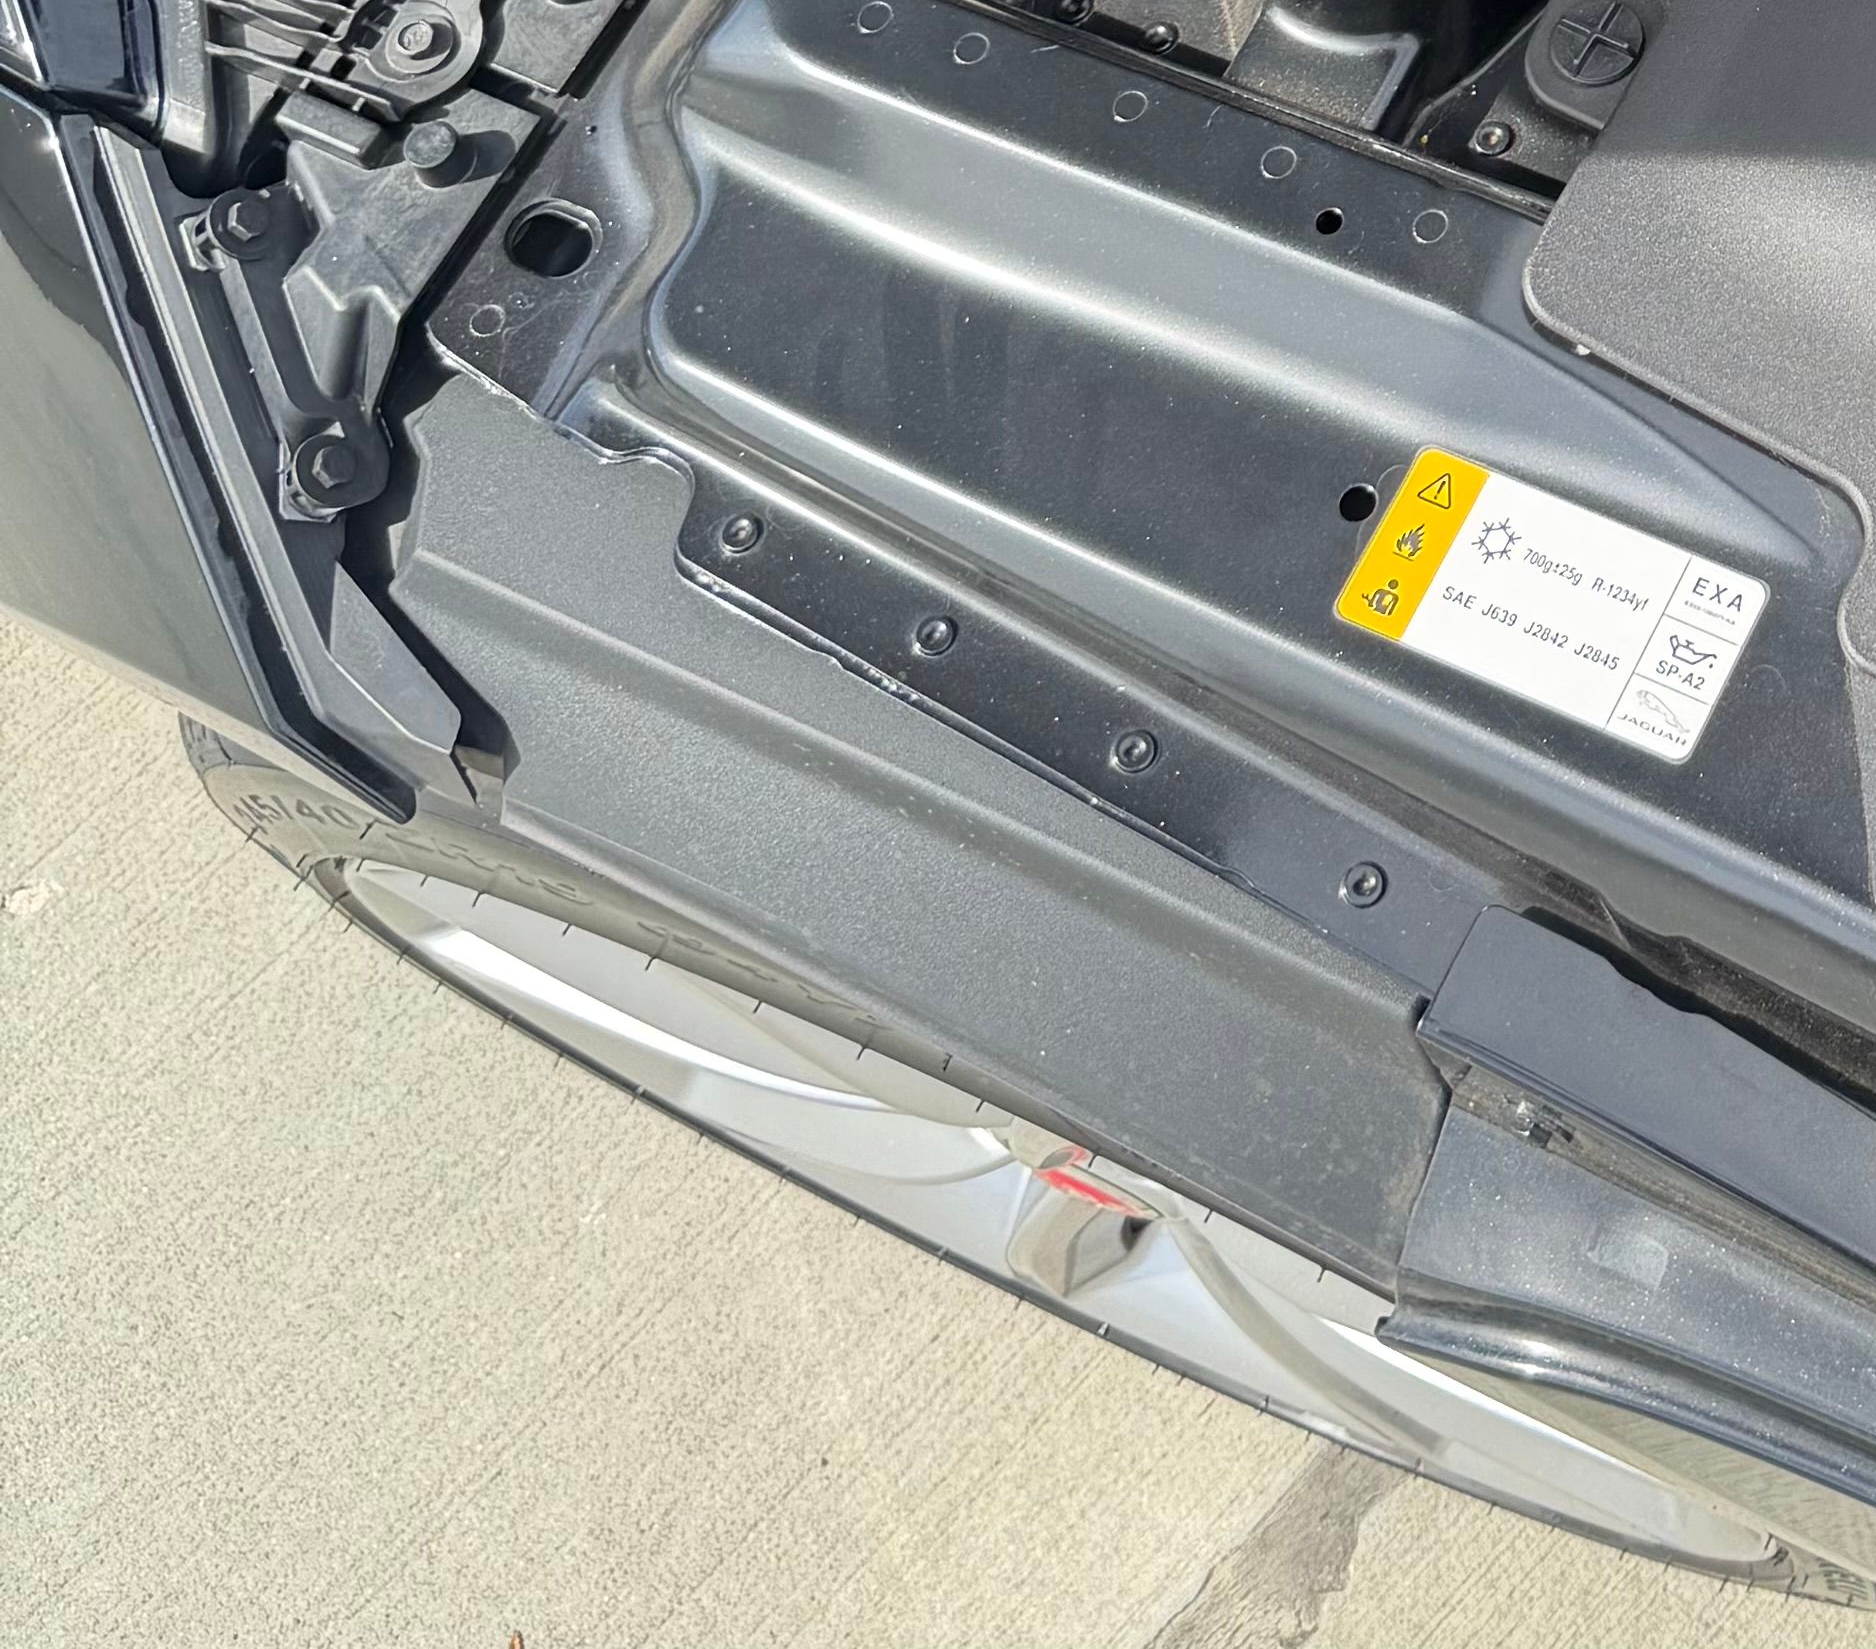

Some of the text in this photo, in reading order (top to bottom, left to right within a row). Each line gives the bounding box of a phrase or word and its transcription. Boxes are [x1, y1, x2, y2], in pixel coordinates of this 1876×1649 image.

[1692, 577, 1743, 612] EXA
[1442, 586, 1620, 672] SAE J639 J2842 J2845
[1656, 661, 1706, 691] SP-A2
[1616, 713, 1688, 747] JAGUAR
